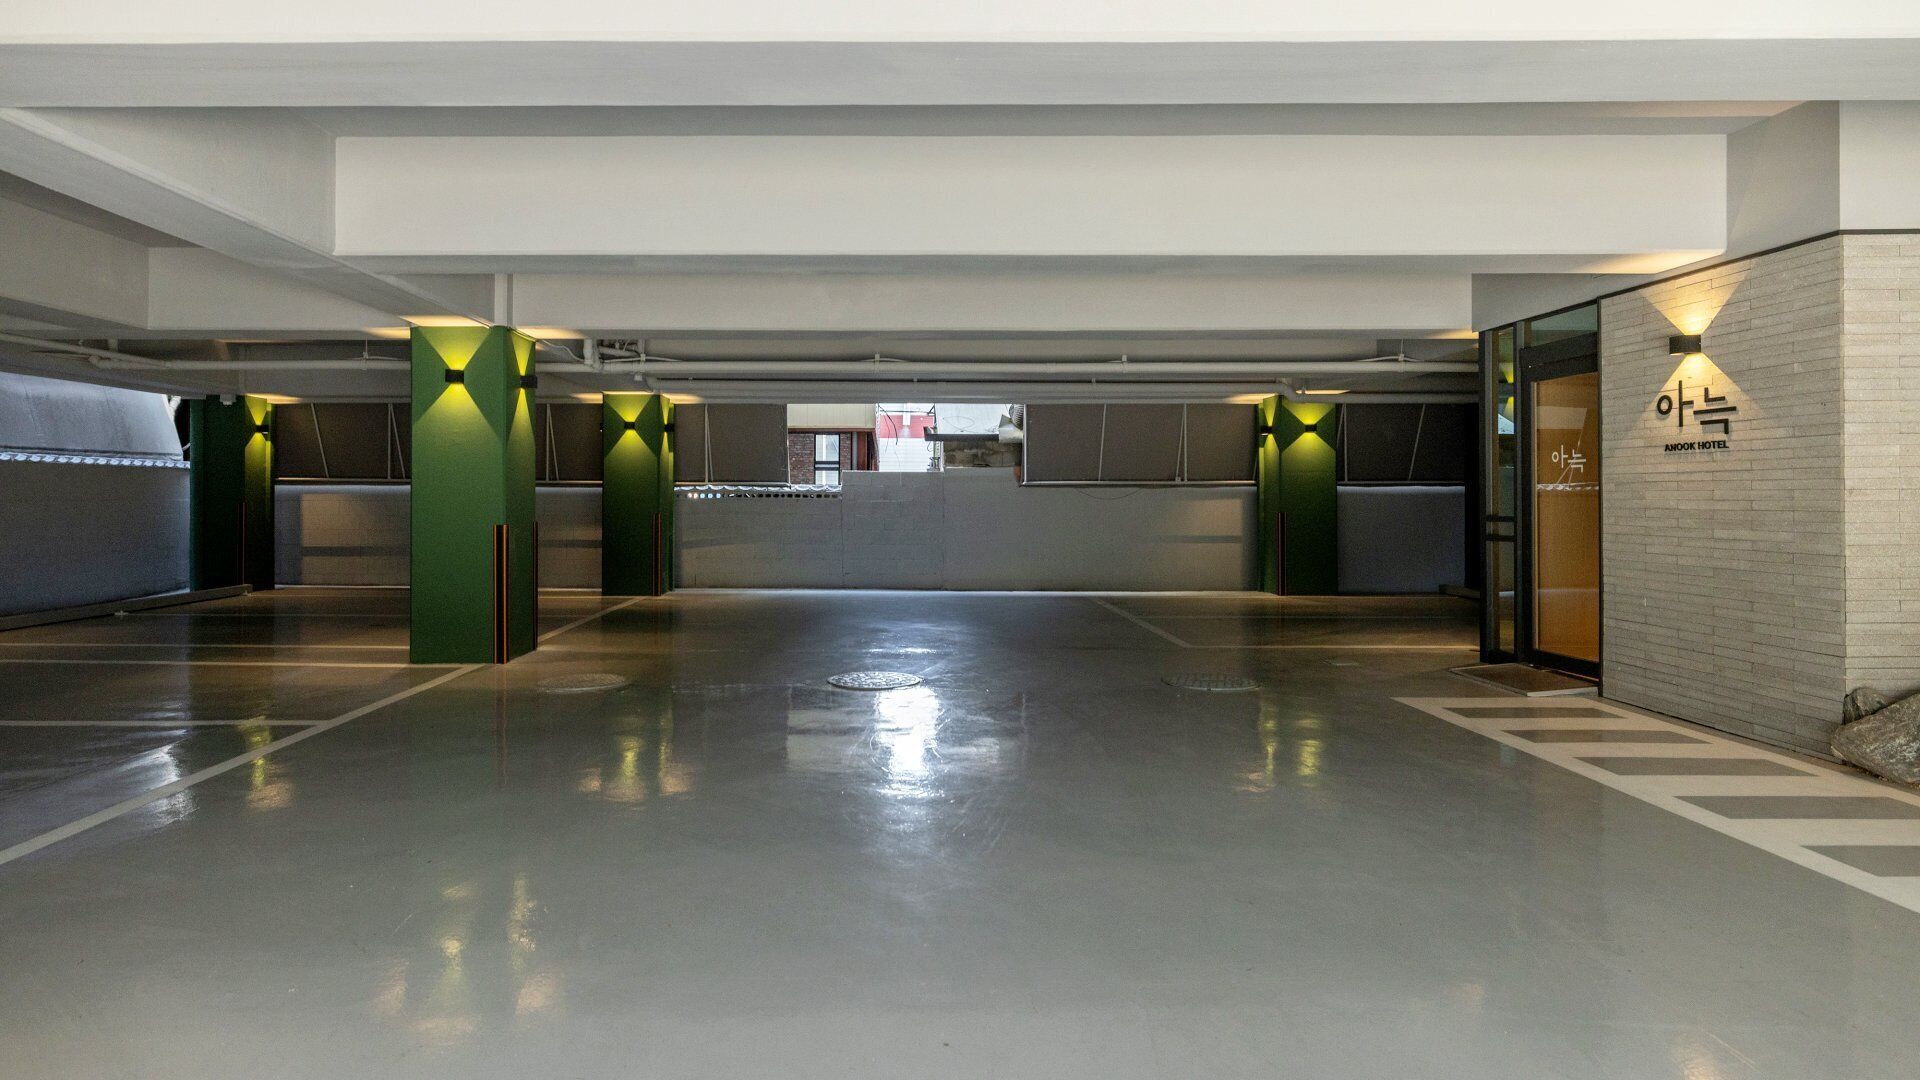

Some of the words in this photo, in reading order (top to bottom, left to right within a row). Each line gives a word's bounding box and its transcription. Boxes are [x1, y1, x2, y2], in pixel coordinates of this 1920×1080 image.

[1656, 380, 1737, 434] 아늑
[1551, 444, 1587, 473] 아늑
[1664, 442, 1696, 452] ANOOK
[1697, 440, 1729, 450] HOTEL
